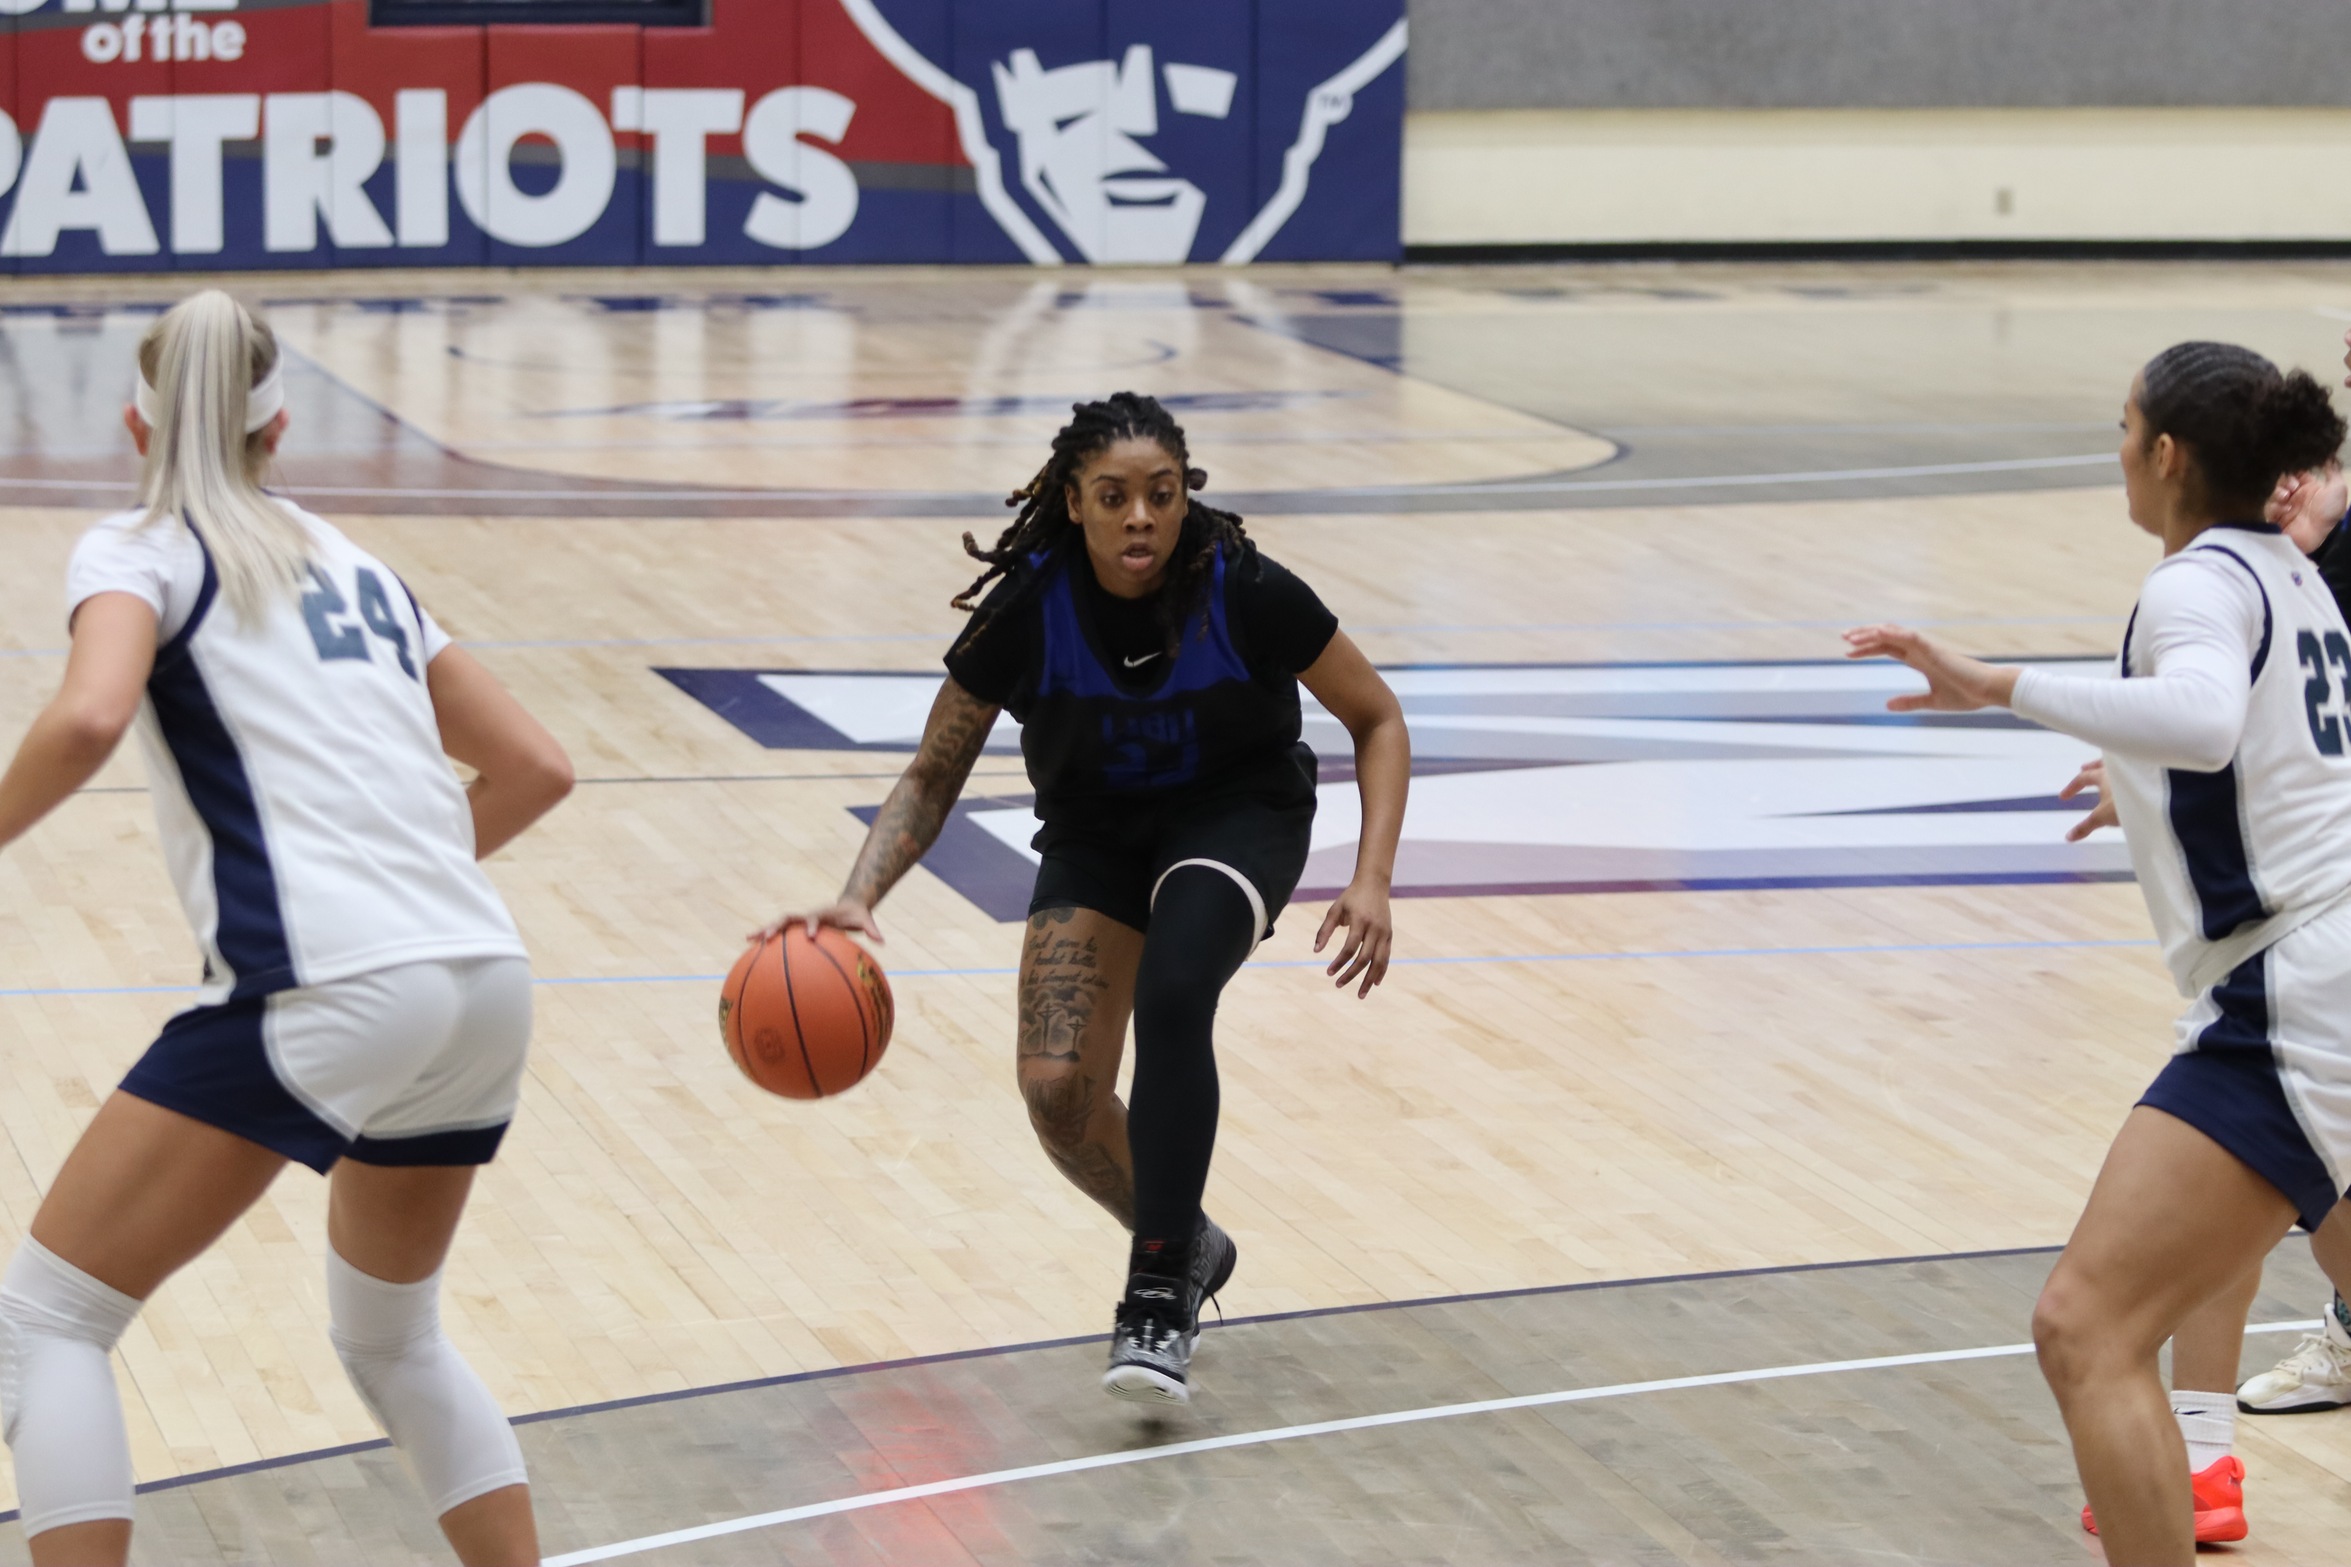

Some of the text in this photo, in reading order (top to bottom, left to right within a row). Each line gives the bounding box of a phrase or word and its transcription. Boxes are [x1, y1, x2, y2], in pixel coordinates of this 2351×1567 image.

[82, 12, 247, 63] of the
[301, 558, 419, 682] 24
